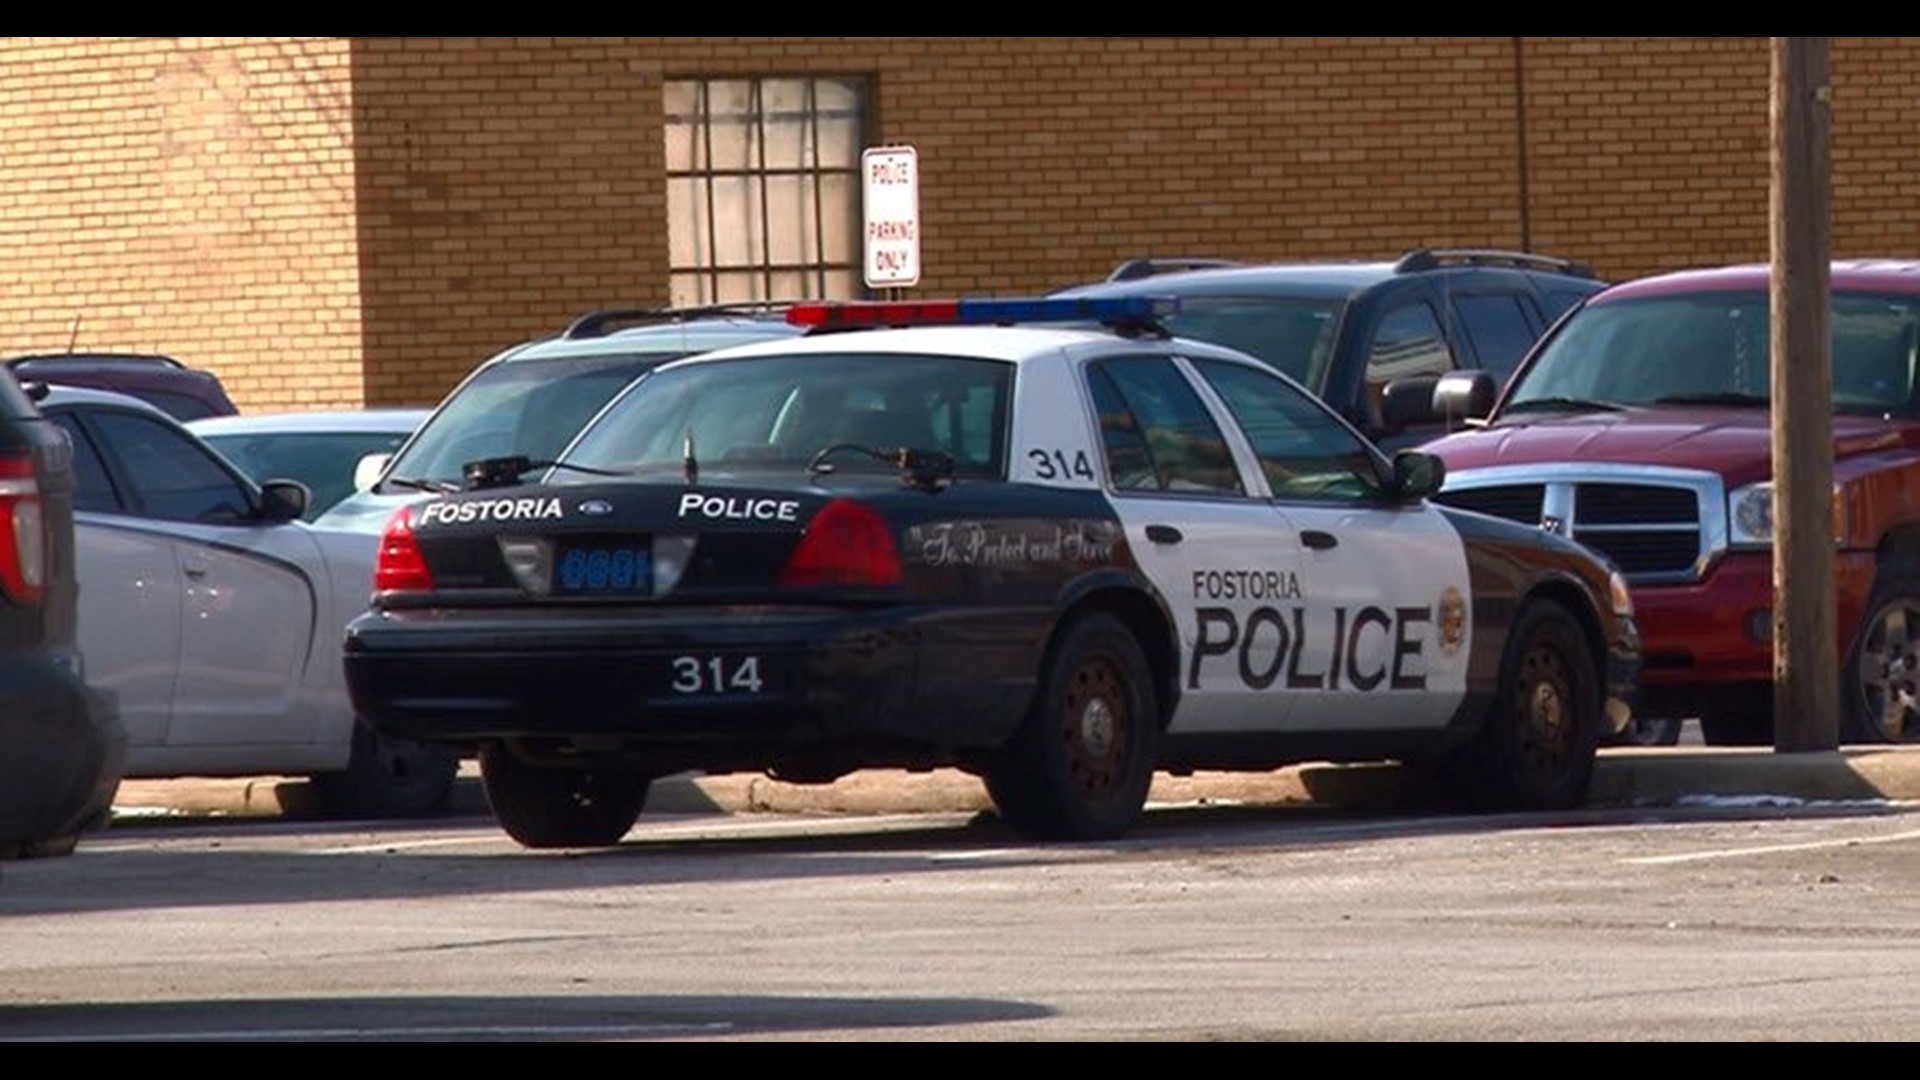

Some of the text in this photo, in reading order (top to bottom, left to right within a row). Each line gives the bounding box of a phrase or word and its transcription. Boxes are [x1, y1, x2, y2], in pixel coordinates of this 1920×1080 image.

[871, 163, 910, 185] POLICE
[868, 219, 914, 241] PARKING
[876, 250, 908, 271] ONLY
[1027, 448, 1095, 481] 314
[419, 492, 800, 527] FOSTORIA POLICE
[1028, 526, 1063, 562] and
[1192, 570, 1301, 600] FOSTORIA
[1186, 605, 1432, 692] POLICE
[671, 656, 763, 693] 314
